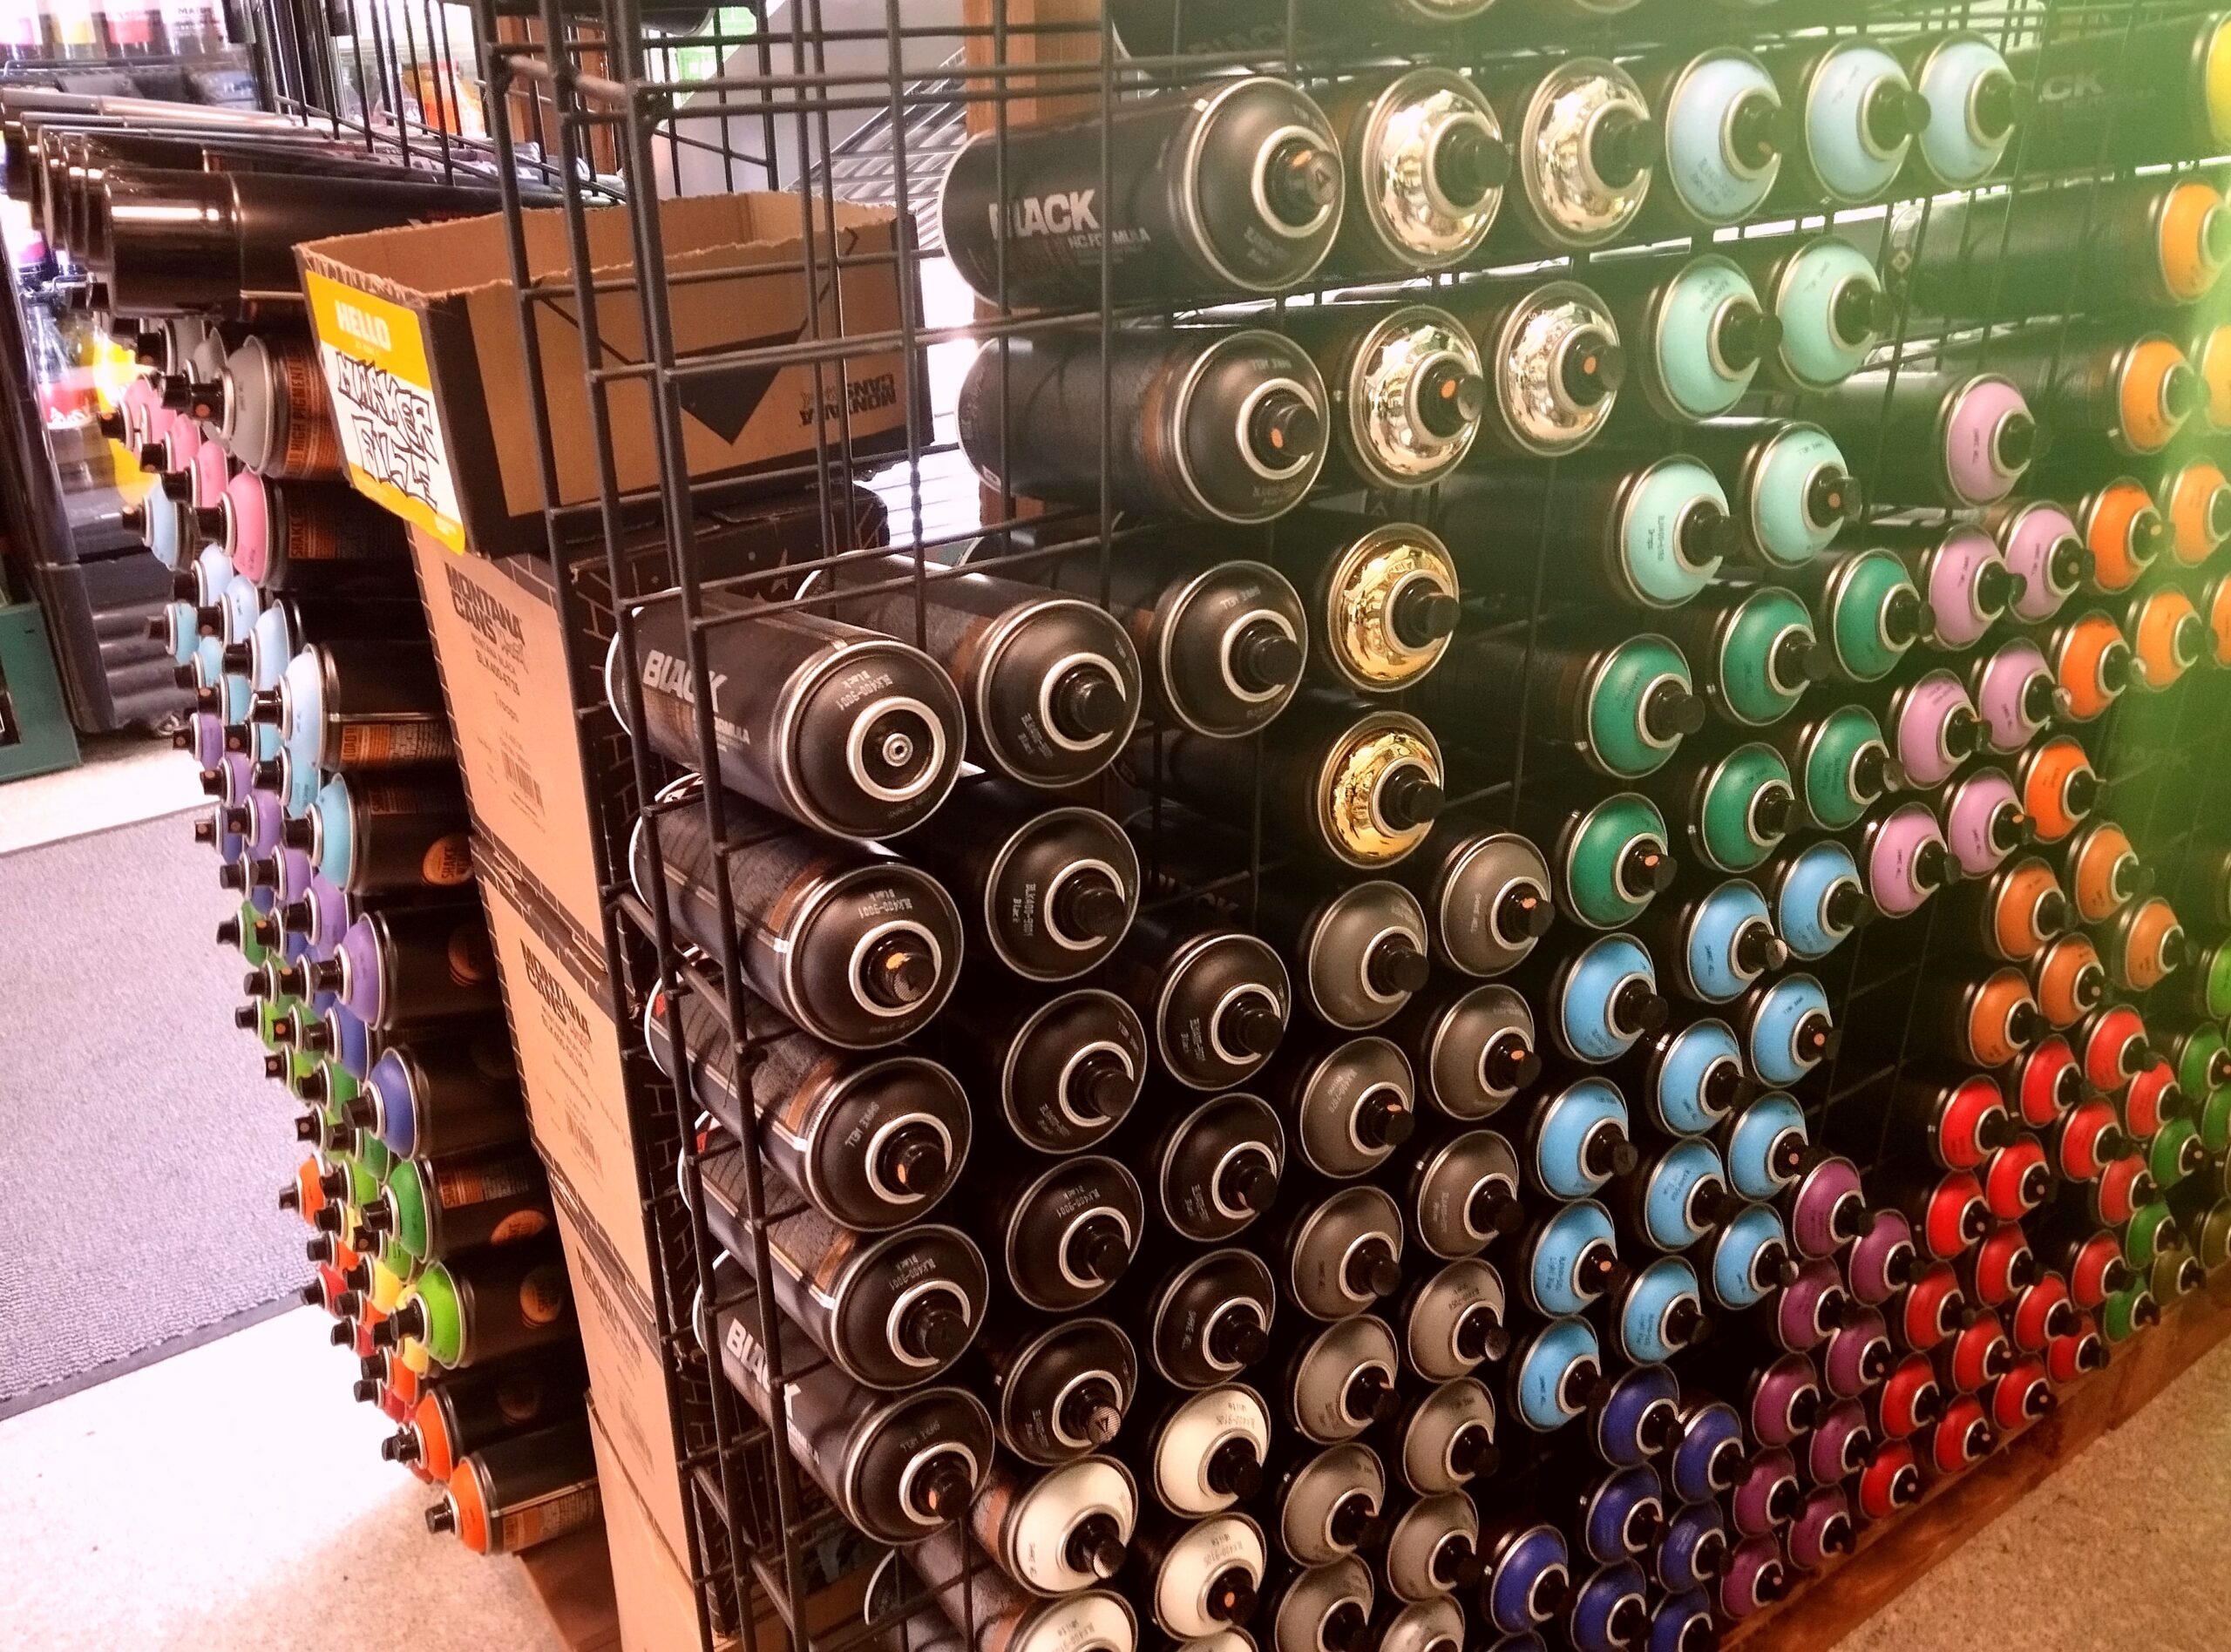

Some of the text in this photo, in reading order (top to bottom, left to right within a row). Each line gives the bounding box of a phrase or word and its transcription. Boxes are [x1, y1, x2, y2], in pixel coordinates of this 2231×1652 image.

[335, 299, 391, 352] HELLO
[444, 562, 526, 647] MONTANA
[451, 589, 498, 646] CANS
[520, 938, 592, 1043] MONTANA
[526, 969, 566, 1026] CANS
